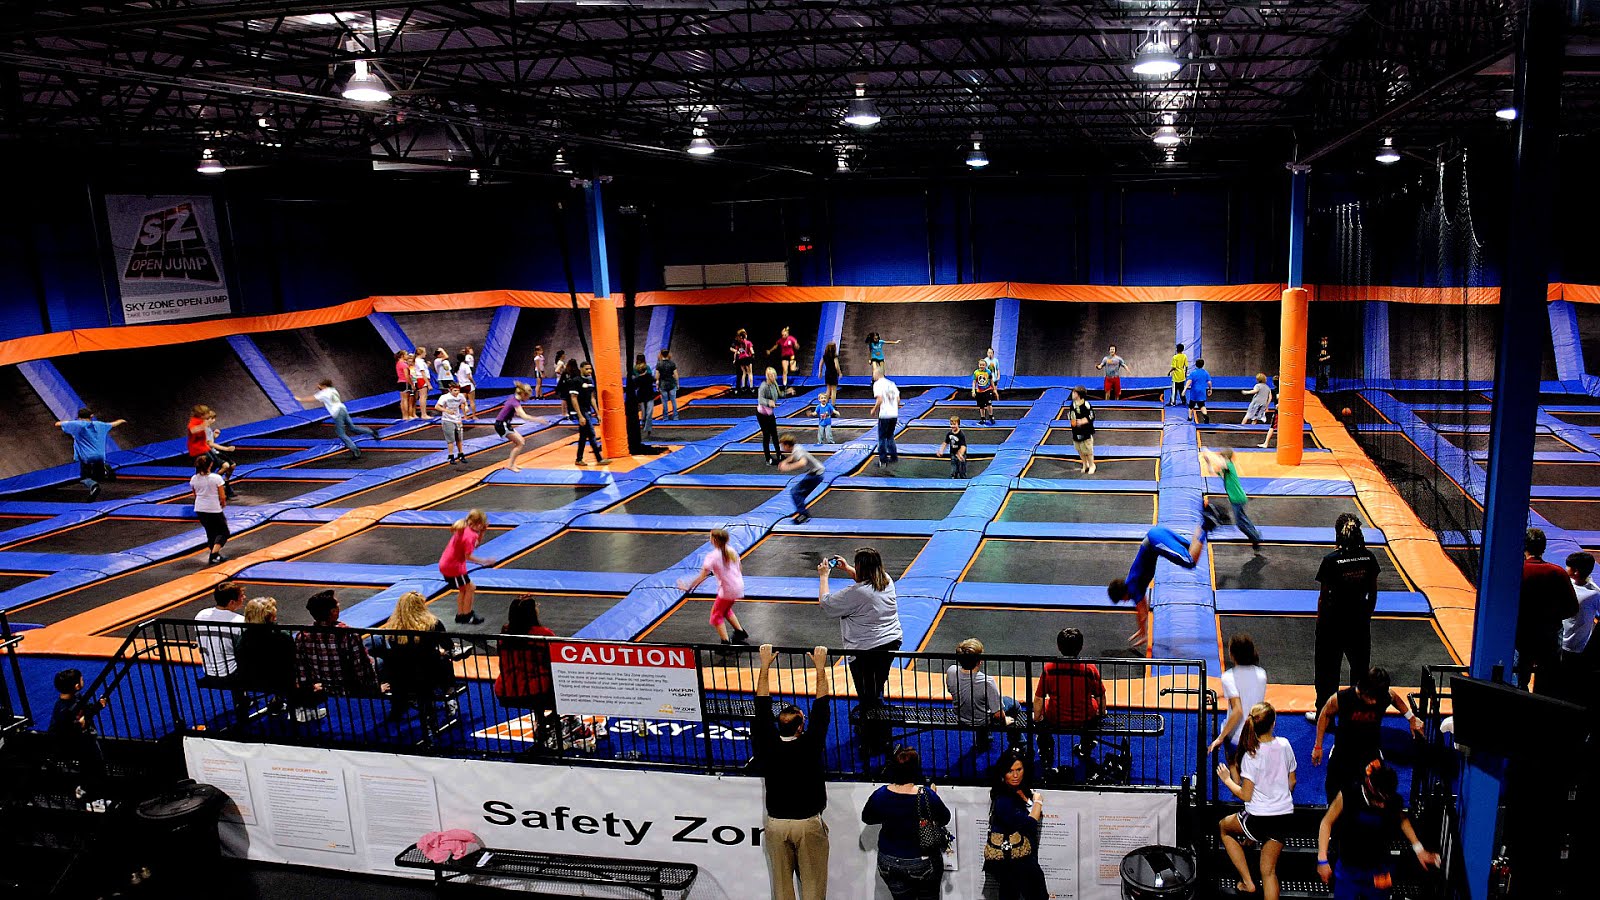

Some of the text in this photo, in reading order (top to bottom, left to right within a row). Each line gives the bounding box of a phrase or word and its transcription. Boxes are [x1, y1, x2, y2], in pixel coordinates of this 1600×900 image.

[131, 256, 208, 271] OPEN JUMP
[125, 295, 228, 312] SKY ZONE OPEN JUMP
[560, 645, 685, 666] CAUTION
[482, 800, 653, 846] Safety
